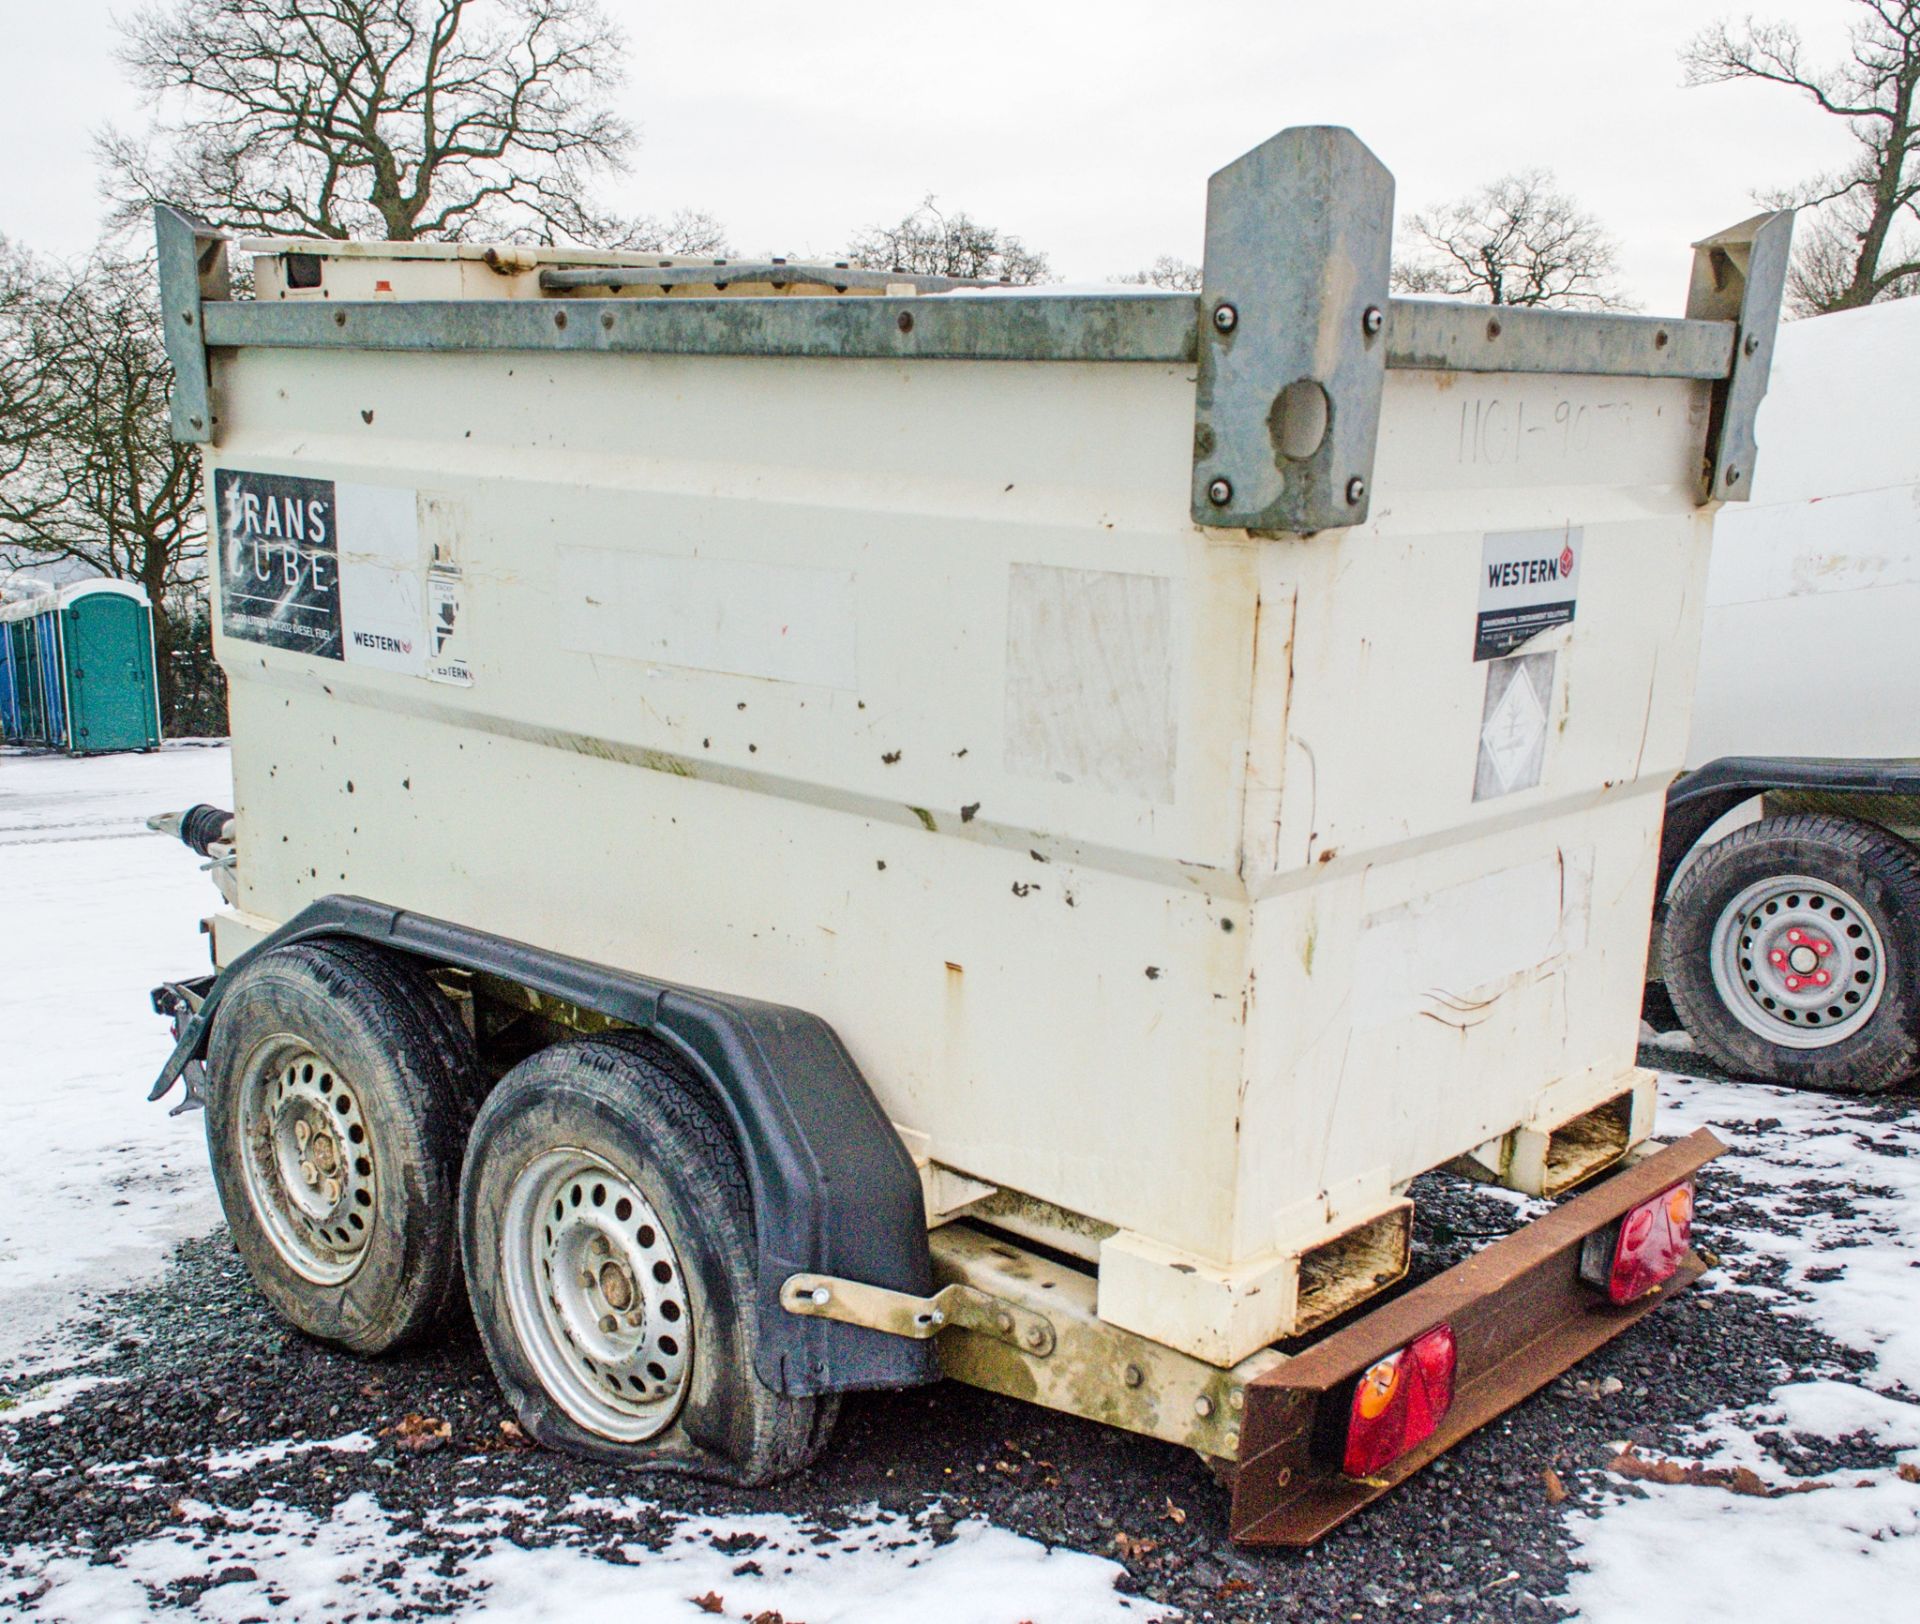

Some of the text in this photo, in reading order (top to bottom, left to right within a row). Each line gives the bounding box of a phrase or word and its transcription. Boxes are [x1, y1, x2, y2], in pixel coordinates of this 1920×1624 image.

[225, 490, 326, 543] TRANS
[228, 538, 329, 592] CUBE
[1488, 558, 1558, 588] WESTERN
[293, 622, 315, 638] DIESEL
[314, 627, 332, 641] FUEL
[353, 631, 401, 653] WESTERN
